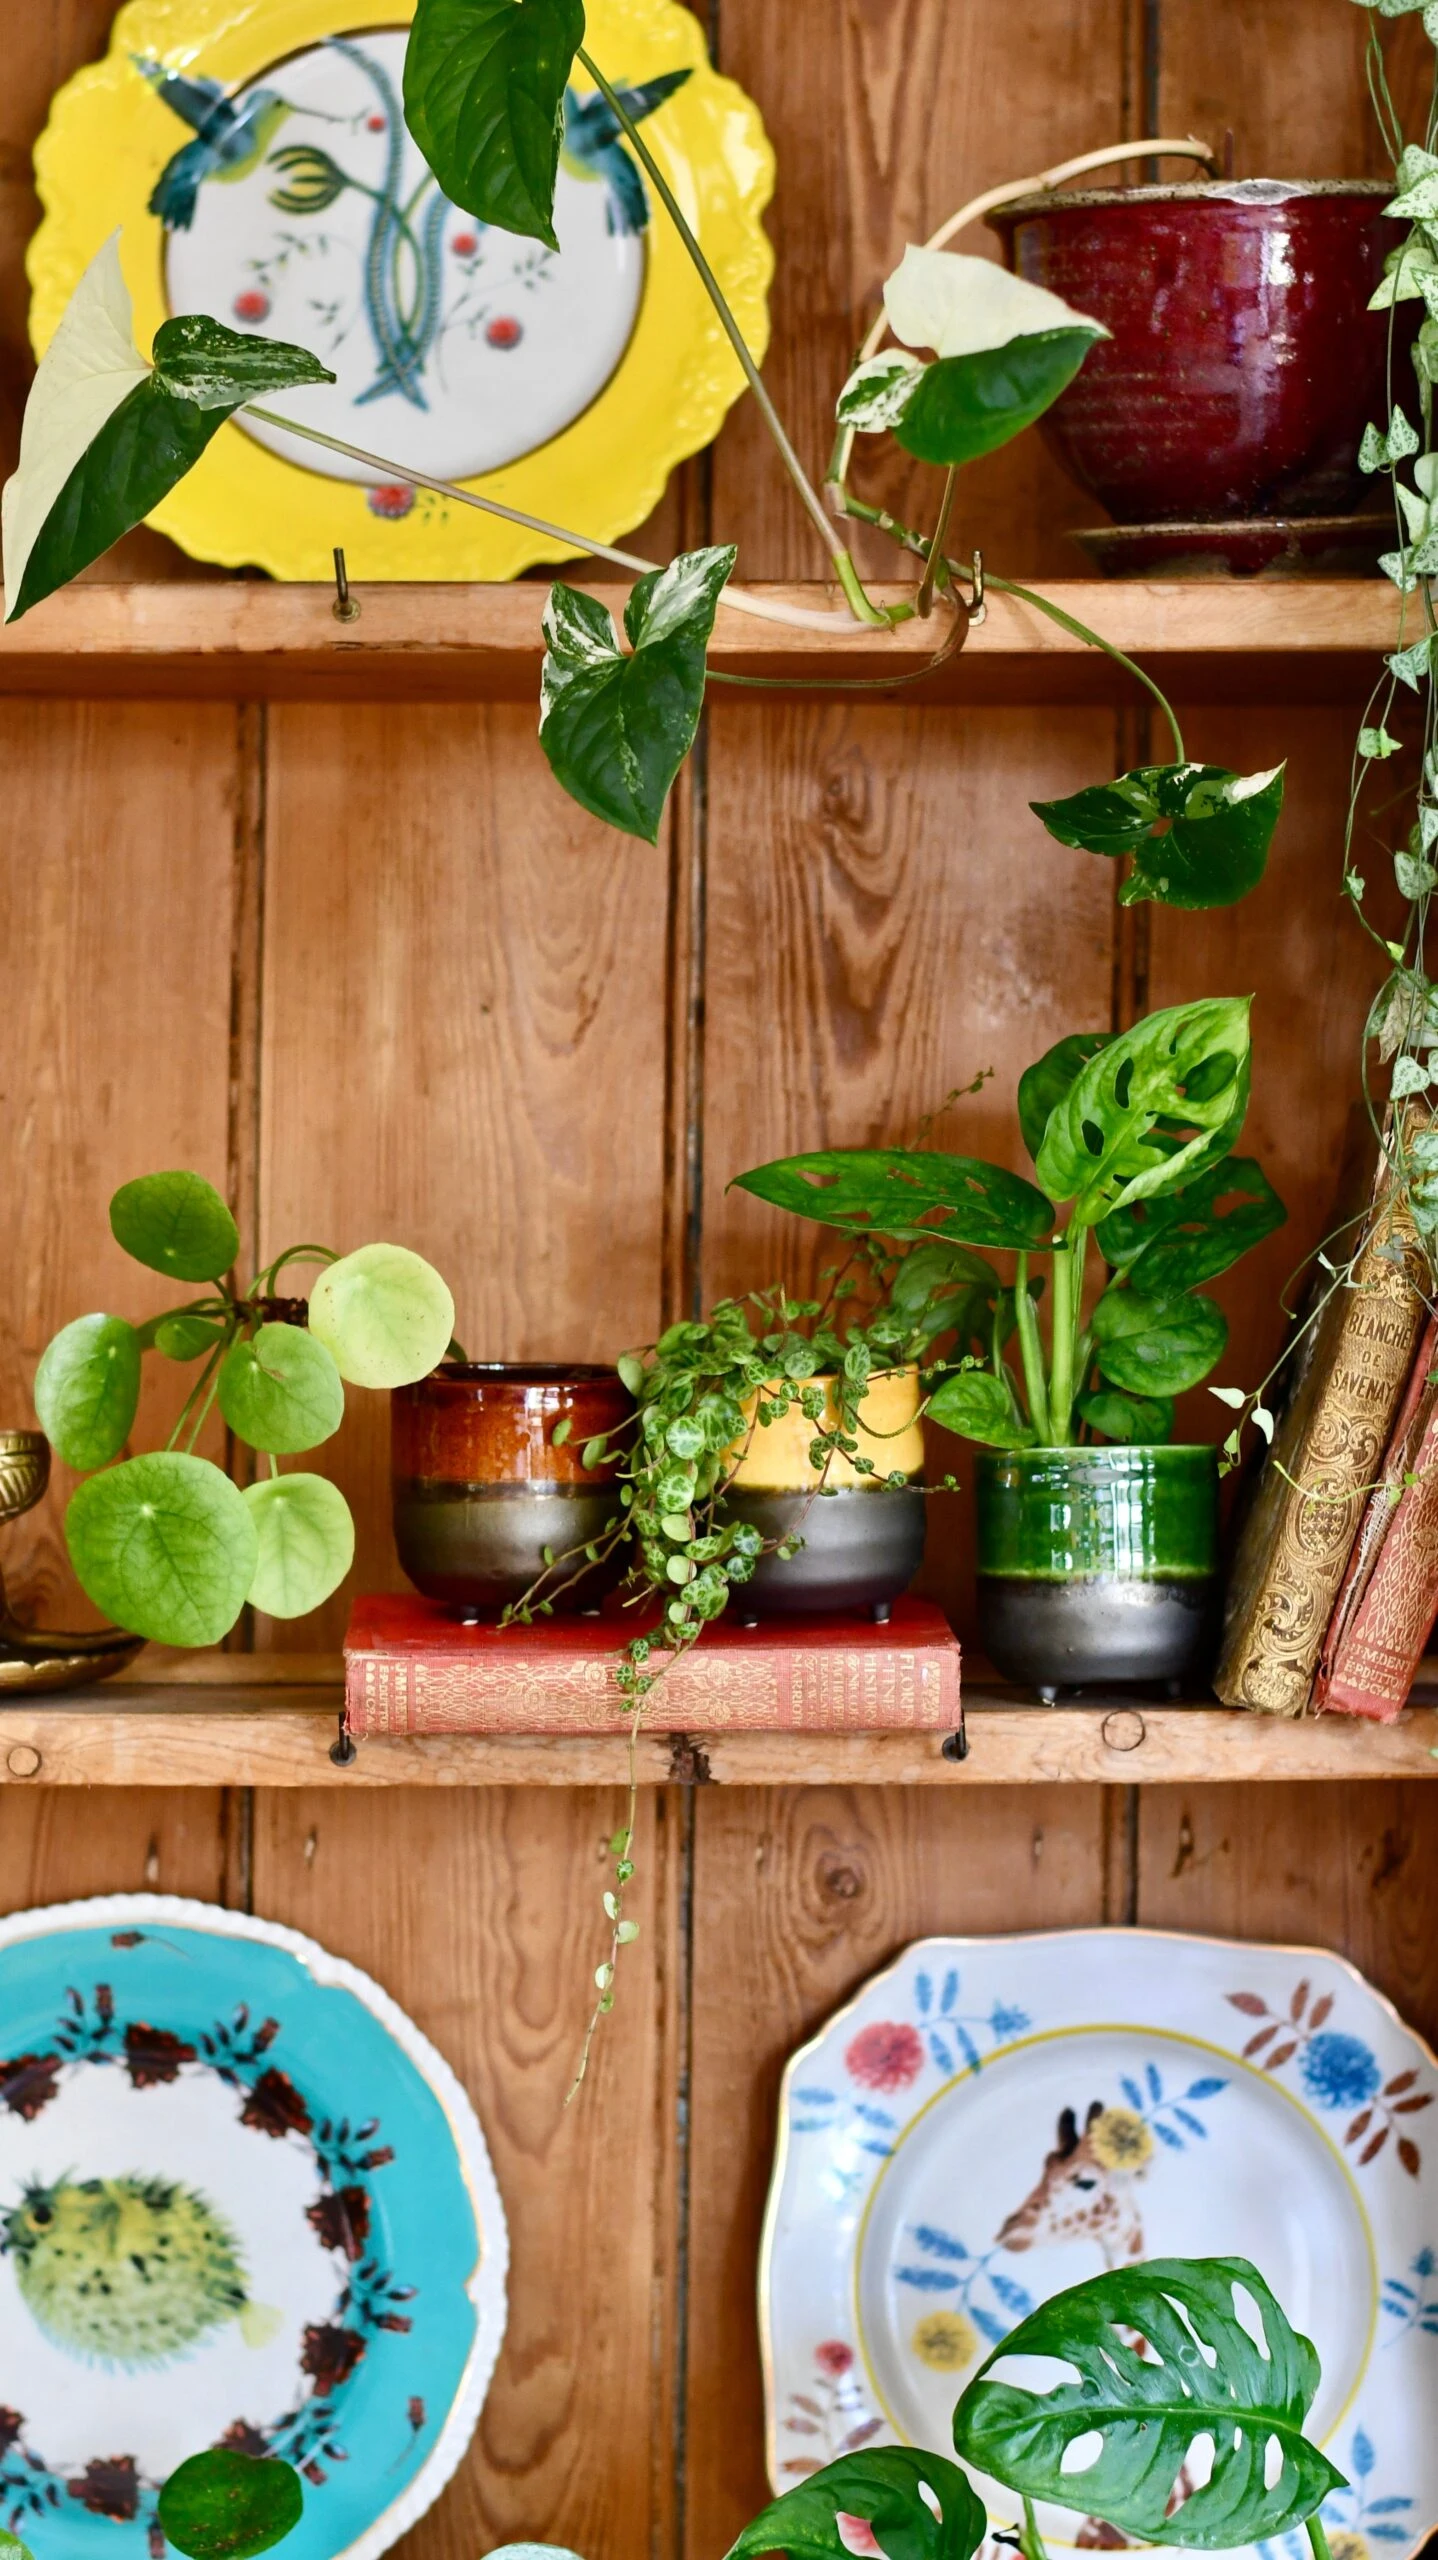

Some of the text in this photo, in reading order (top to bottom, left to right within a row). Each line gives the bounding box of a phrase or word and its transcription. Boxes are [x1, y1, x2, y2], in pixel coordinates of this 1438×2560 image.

[1347, 1311, 1412, 1350] BLANCHE
[1362, 1350, 1382, 1368] DE
[1331, 1368, 1396, 1406] SAVENAY
[864, 1653, 878, 1725] HISTORY
